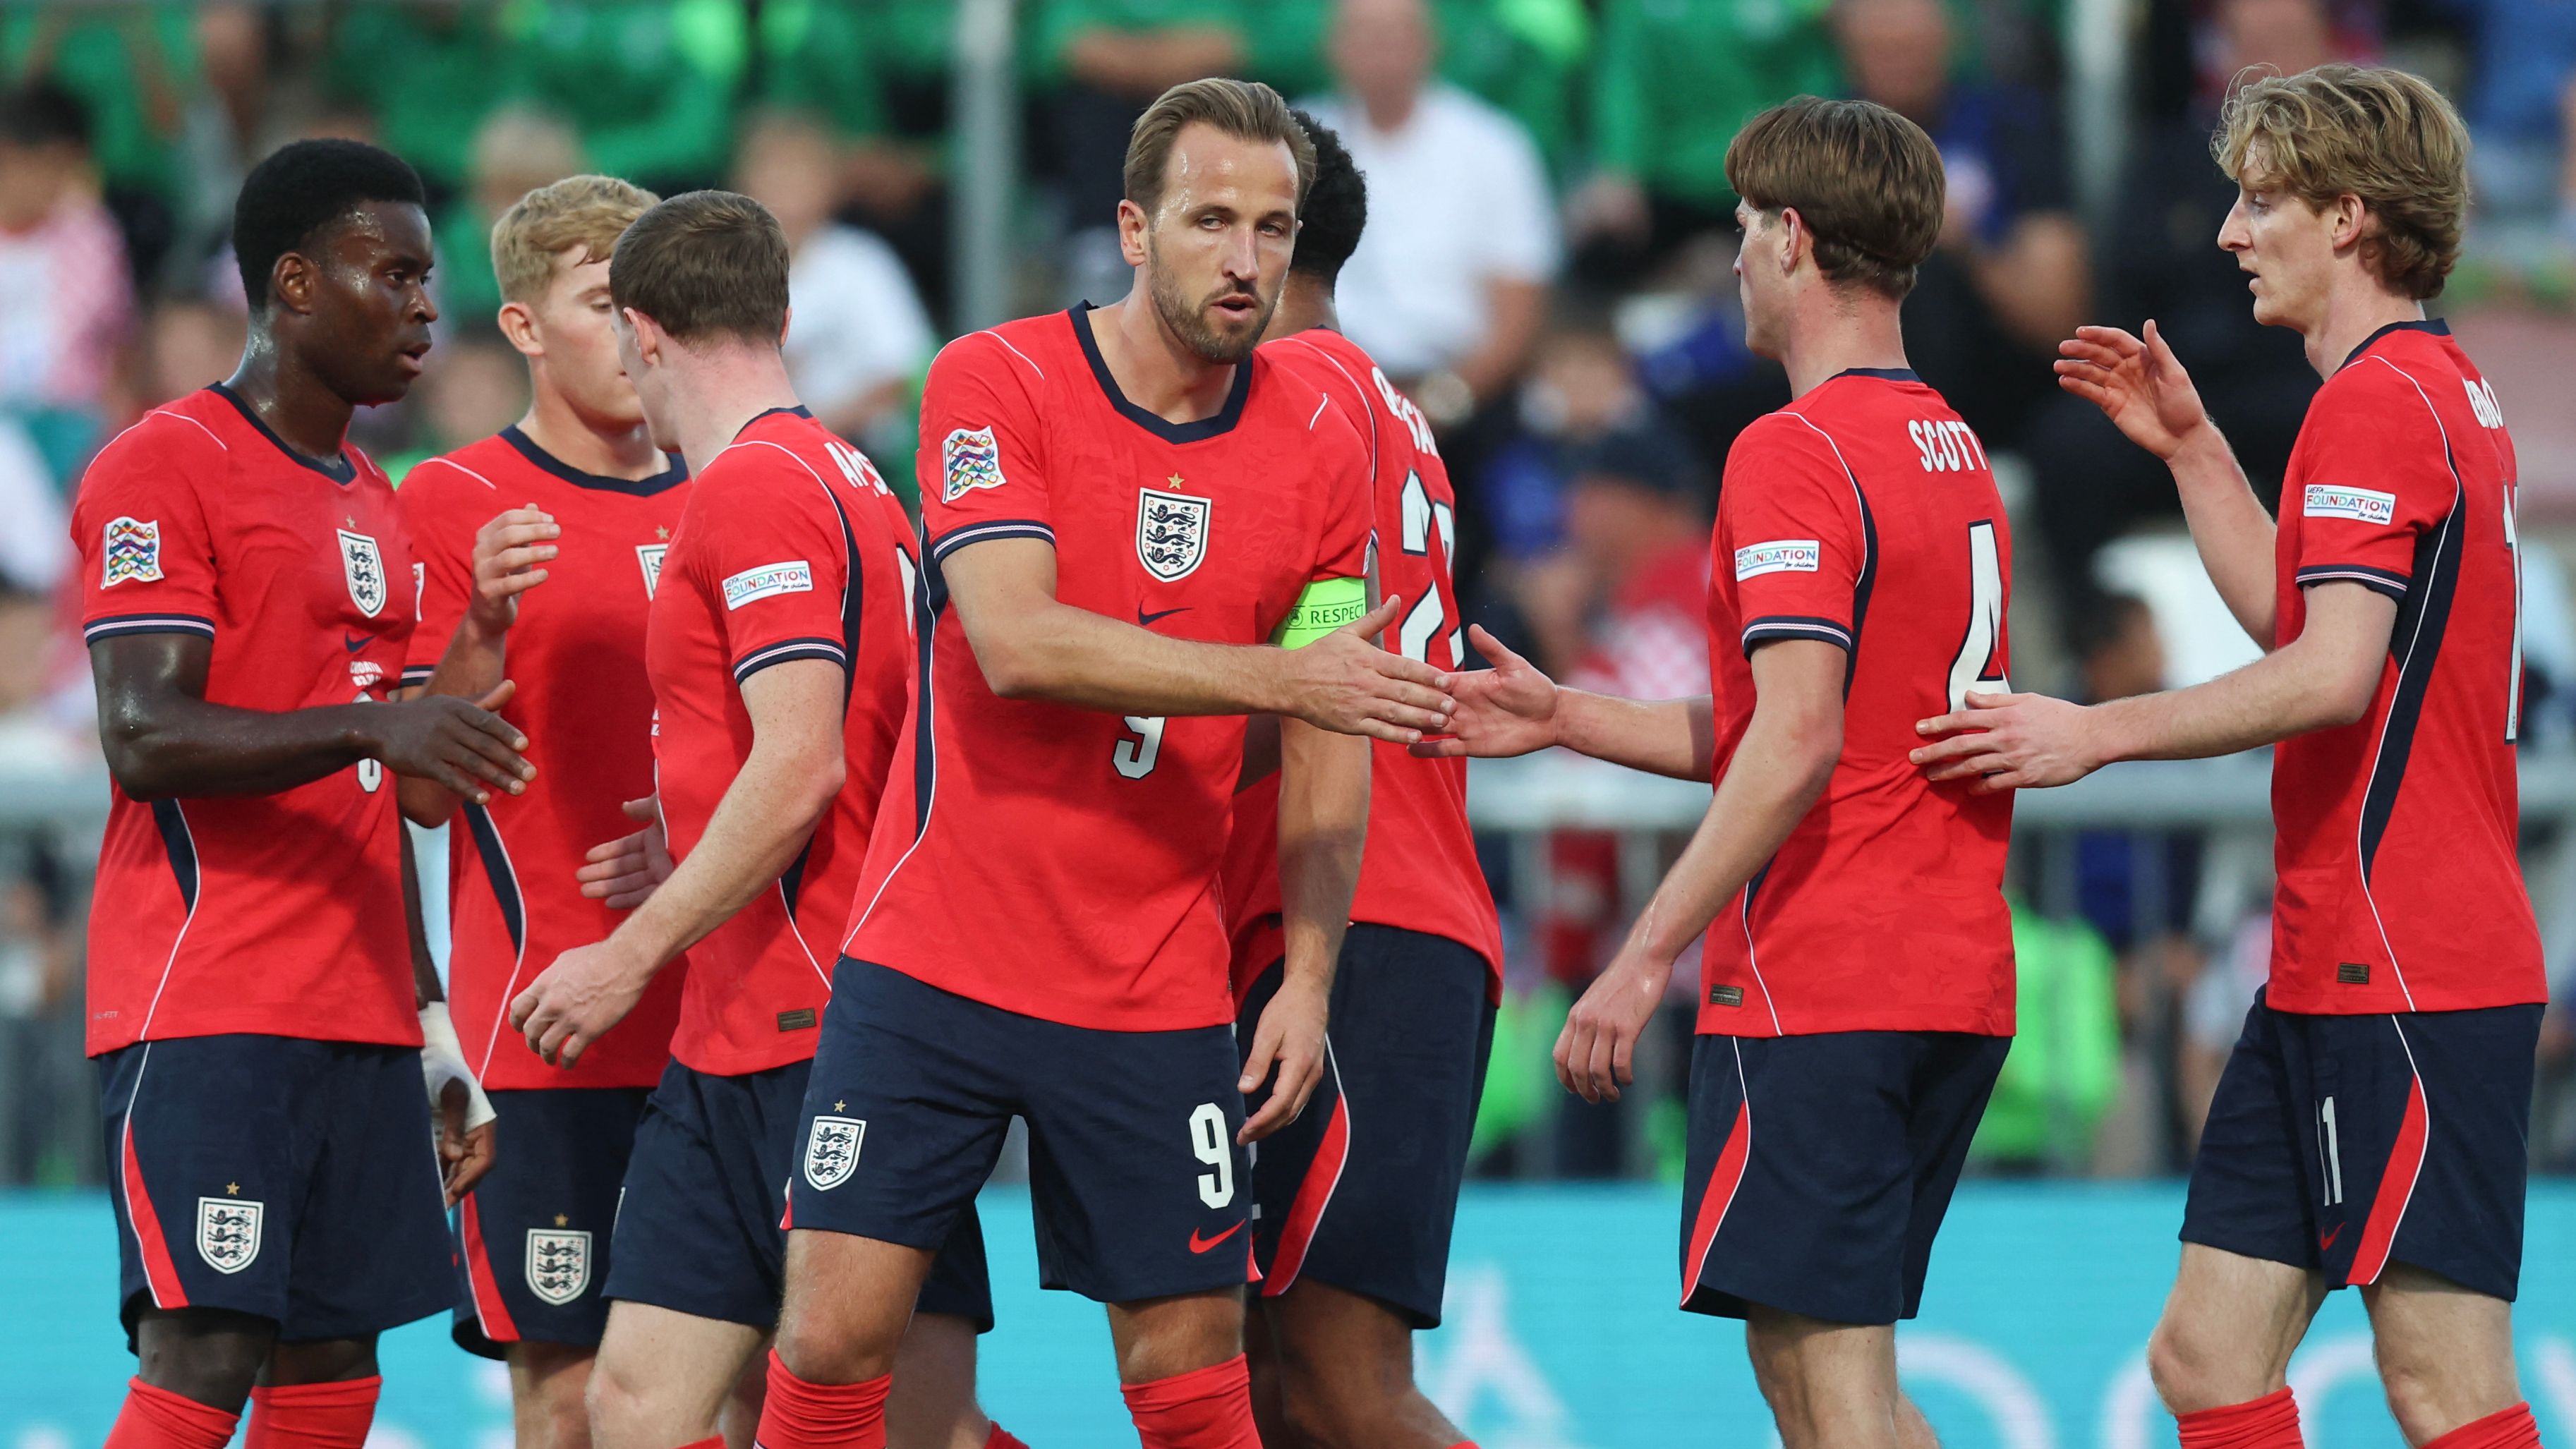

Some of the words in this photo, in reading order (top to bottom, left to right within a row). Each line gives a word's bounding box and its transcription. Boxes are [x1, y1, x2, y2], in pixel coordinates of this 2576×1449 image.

[1908, 419, 1987, 473] SCOTT
[2306, 495, 2390, 514] FOUNDATION
[2368, 513, 2388, 521] children
[1737, 550, 1815, 570] FOUNDATION
[726, 570, 809, 600] FOUNDATION
[1310, 604, 1364, 624] RESPECT
[1189, 1102, 1235, 1210] 9
